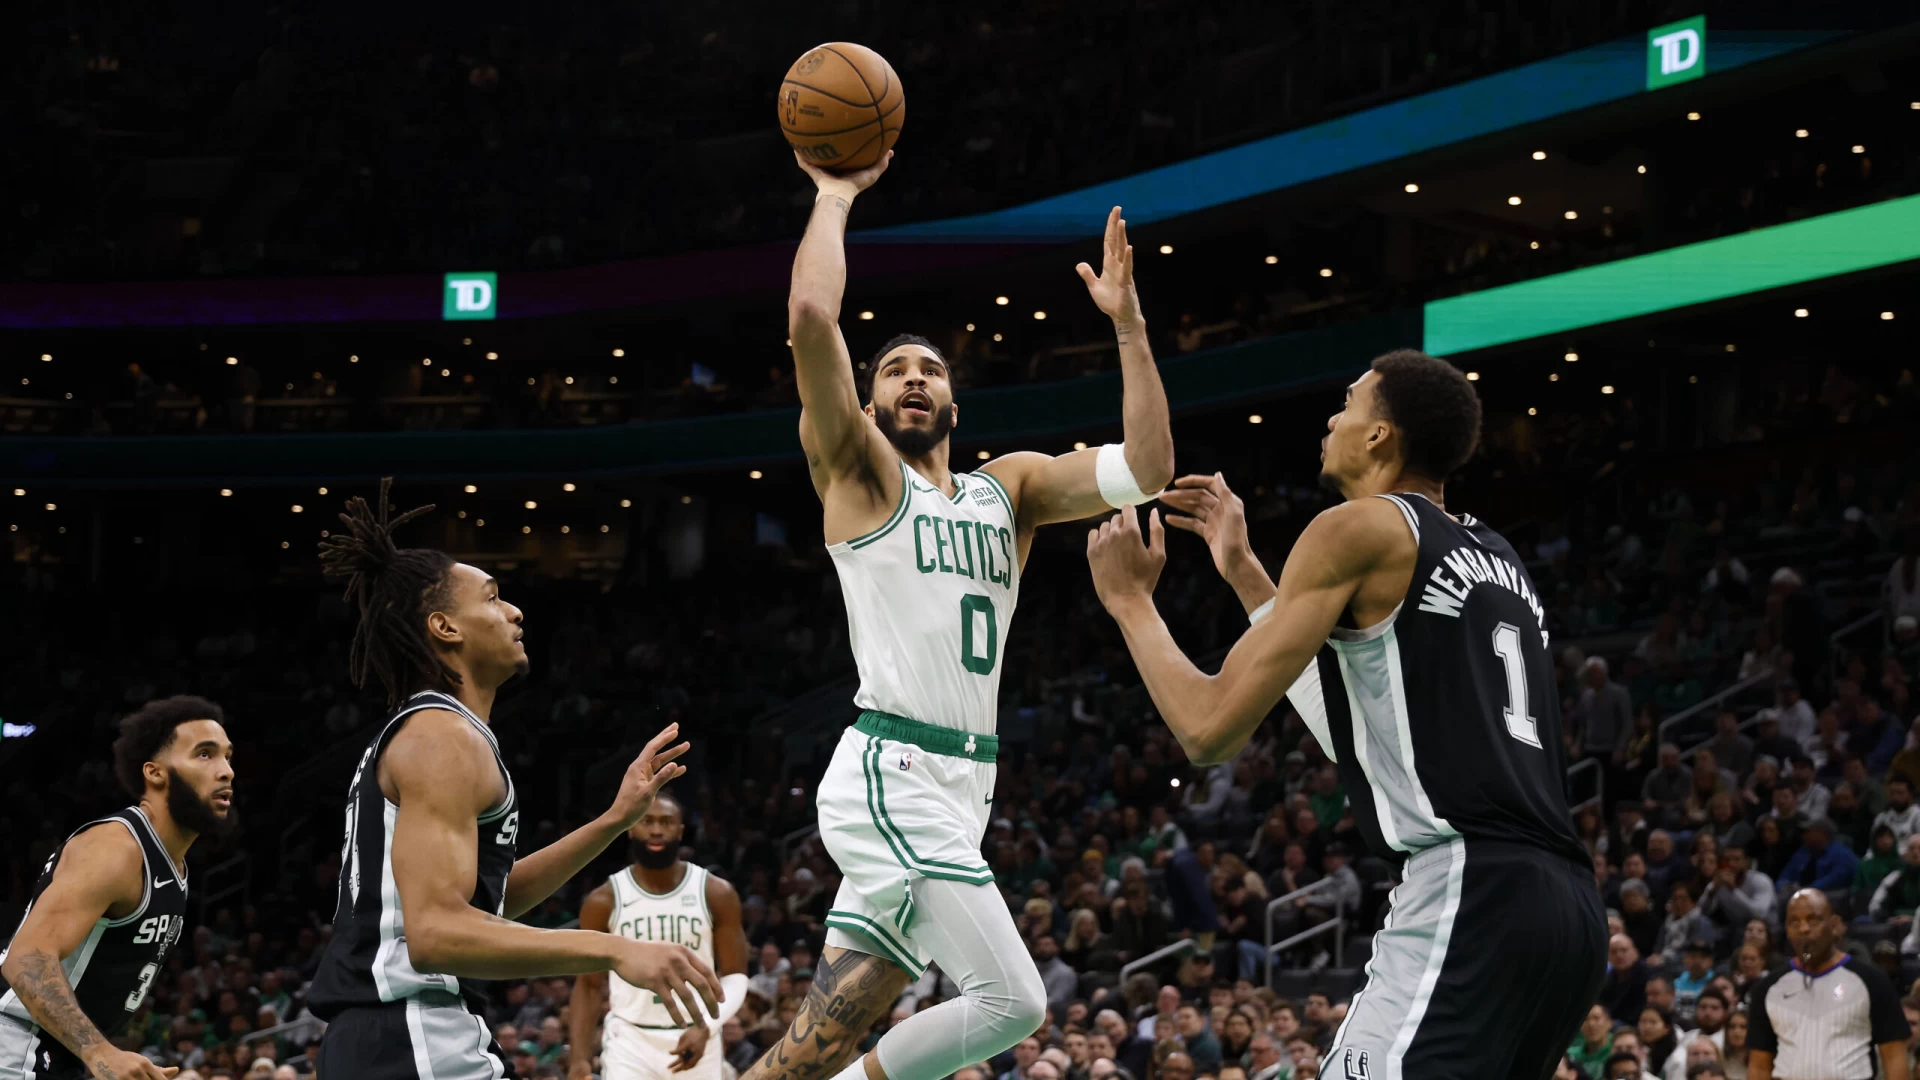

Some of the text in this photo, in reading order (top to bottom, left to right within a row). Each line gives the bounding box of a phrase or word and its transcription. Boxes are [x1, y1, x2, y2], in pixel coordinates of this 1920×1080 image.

[1652, 28, 1700, 76] TD
[449, 280, 492, 311] TD
[970, 487, 996, 500] VISTA
[974, 496, 1000, 507] PRINT
[913, 514, 1011, 590] CELTICS
[960, 593, 997, 676] 0
[1491, 620, 1543, 750] 1
[124, 961, 158, 1012] 3
